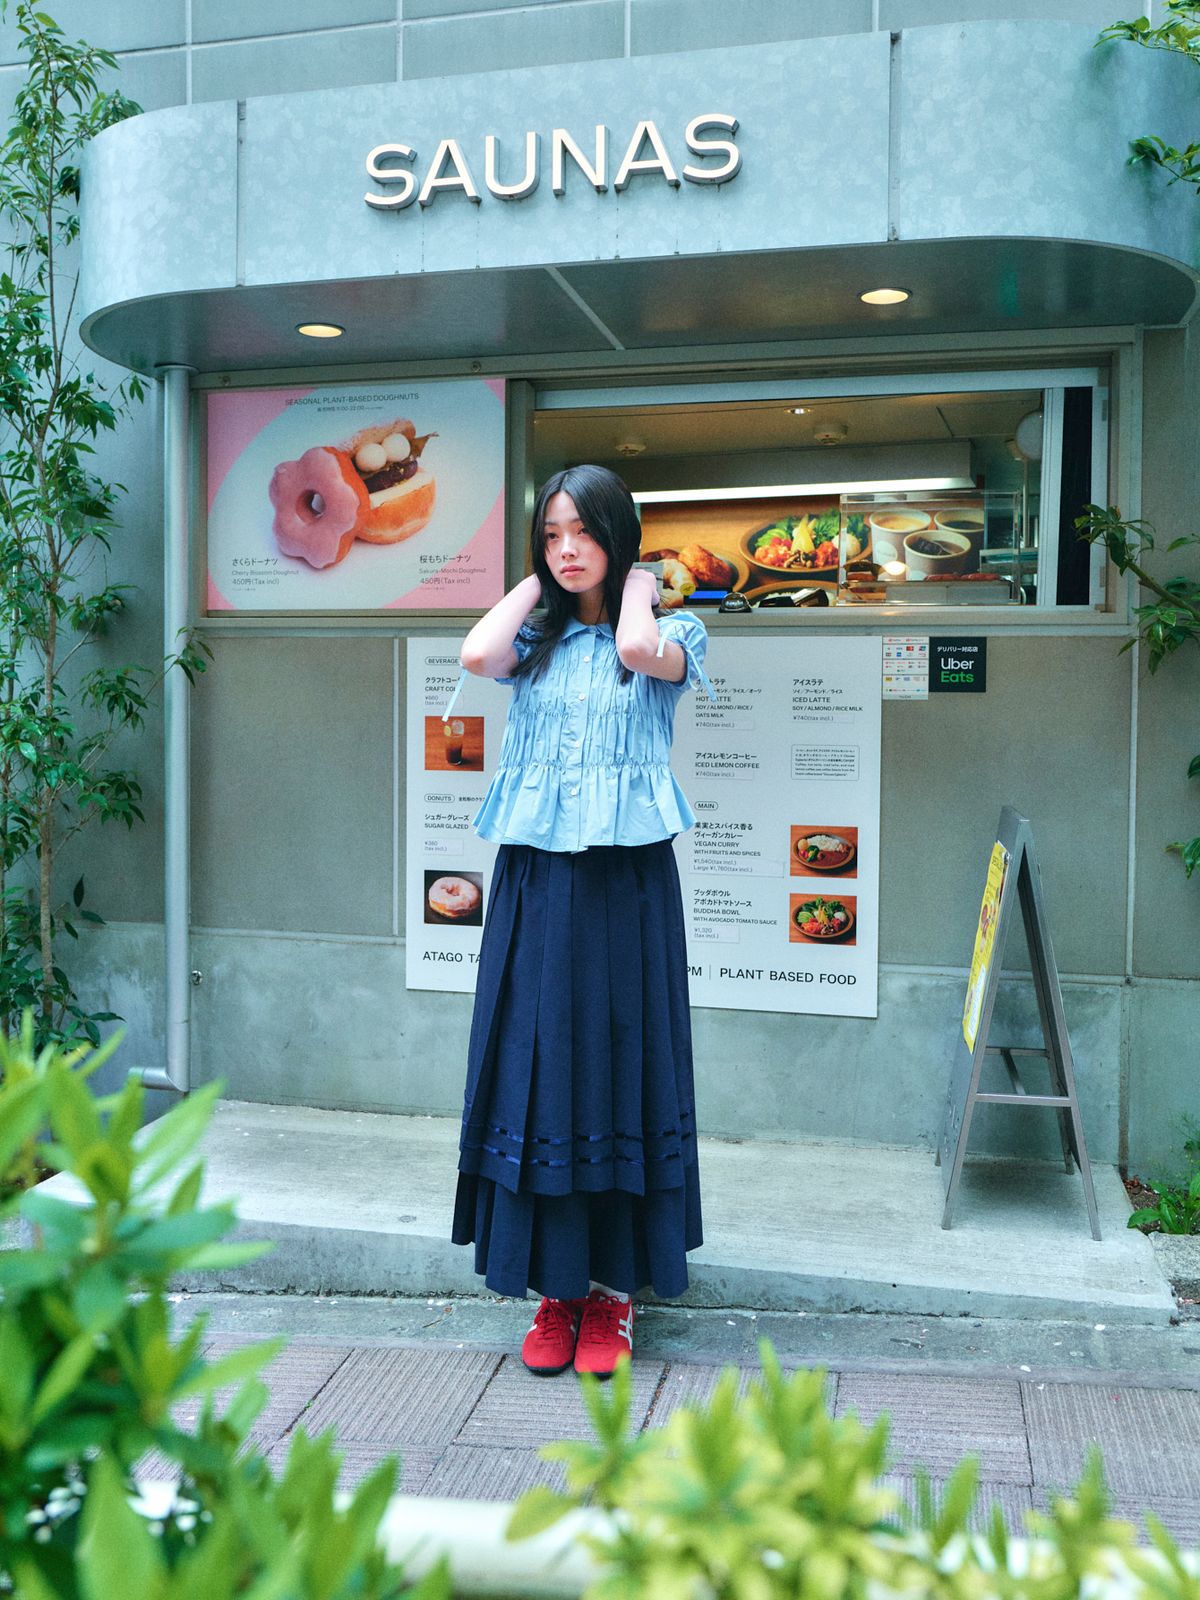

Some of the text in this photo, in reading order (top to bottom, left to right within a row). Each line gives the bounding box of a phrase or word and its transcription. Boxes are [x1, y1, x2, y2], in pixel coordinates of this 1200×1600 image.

[364, 113, 742, 210] SAUNAS
[322, 396, 372, 404] PLANT-BASED
[374, 393, 420, 401] DOUGHNUTS
[231, 558, 278, 567] さくらドーナツ
[419, 555, 471, 563] 桜もちドーナツ
[940, 657, 975, 670] Uber
[940, 671, 975, 683] Eats
[695, 678, 726, 686] ホトラテ
[793, 678, 824, 686] アイスラテ
[695, 752, 757, 760] アイスレモンコーヒー
[694, 831, 743, 839] ヴィーガンカレー
[693, 898, 753, 907] アボカドトマトソース
[422, 951, 463, 963] ATAGO
[719, 967, 764, 980] PLANT
[769, 970, 814, 983] BASED
[819, 973, 857, 985] FOOD
